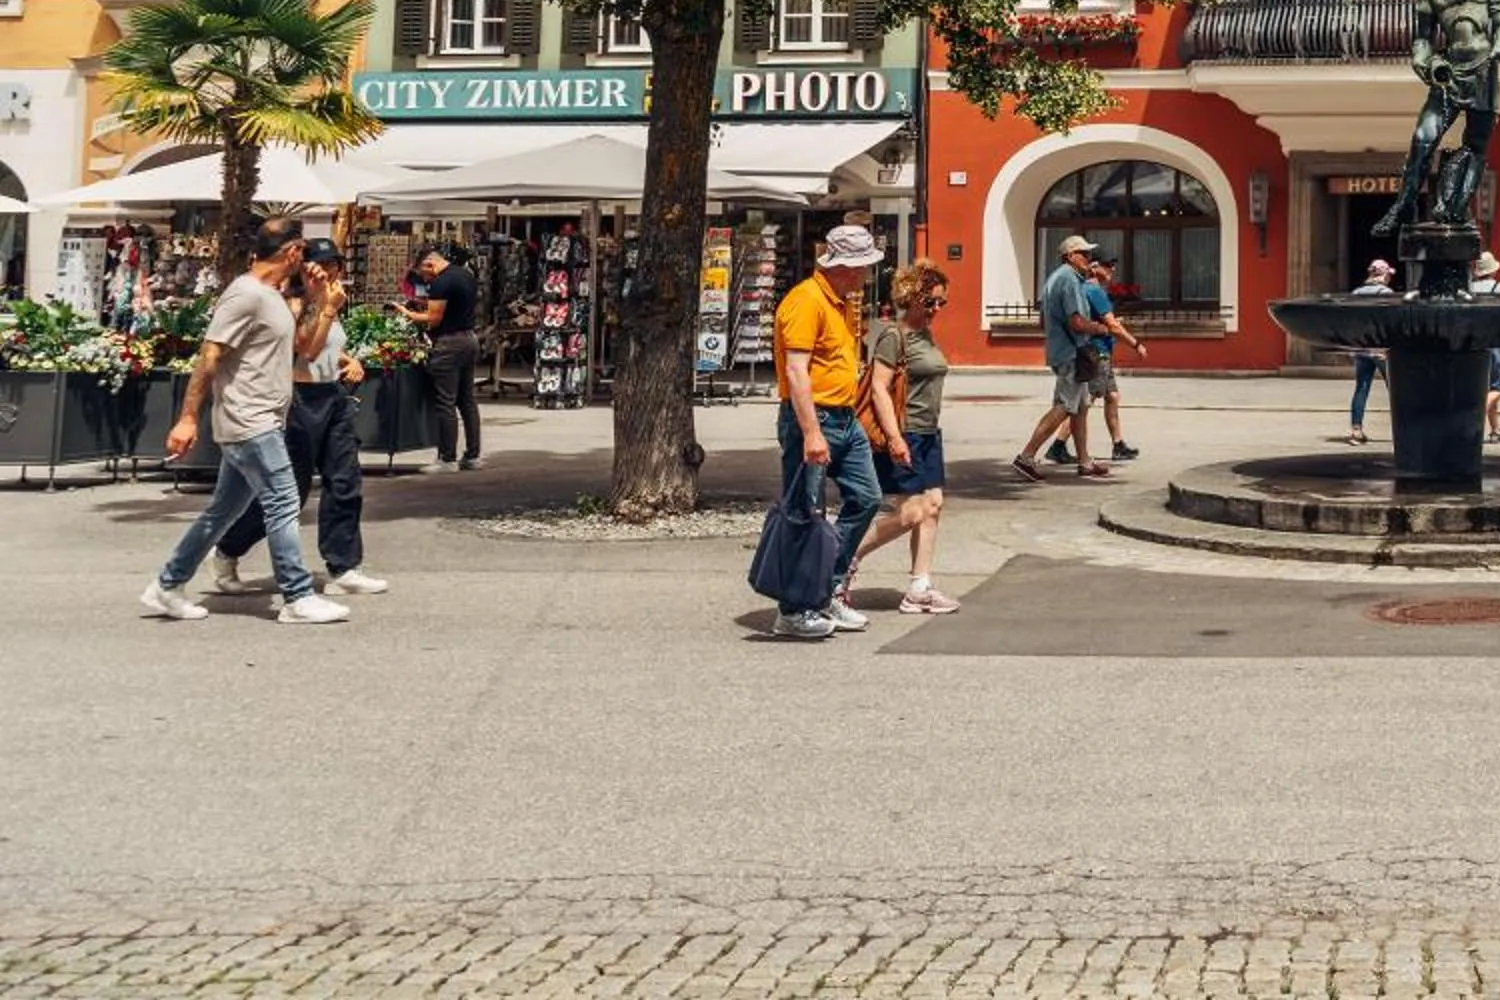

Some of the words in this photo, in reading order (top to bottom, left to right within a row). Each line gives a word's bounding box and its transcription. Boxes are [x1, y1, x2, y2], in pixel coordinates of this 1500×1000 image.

[359, 79, 455, 110] CITY
[465, 78, 628, 109] ZIMMER
[732, 71, 888, 112] PHOTO
[1347, 176, 1401, 194] HOTE
